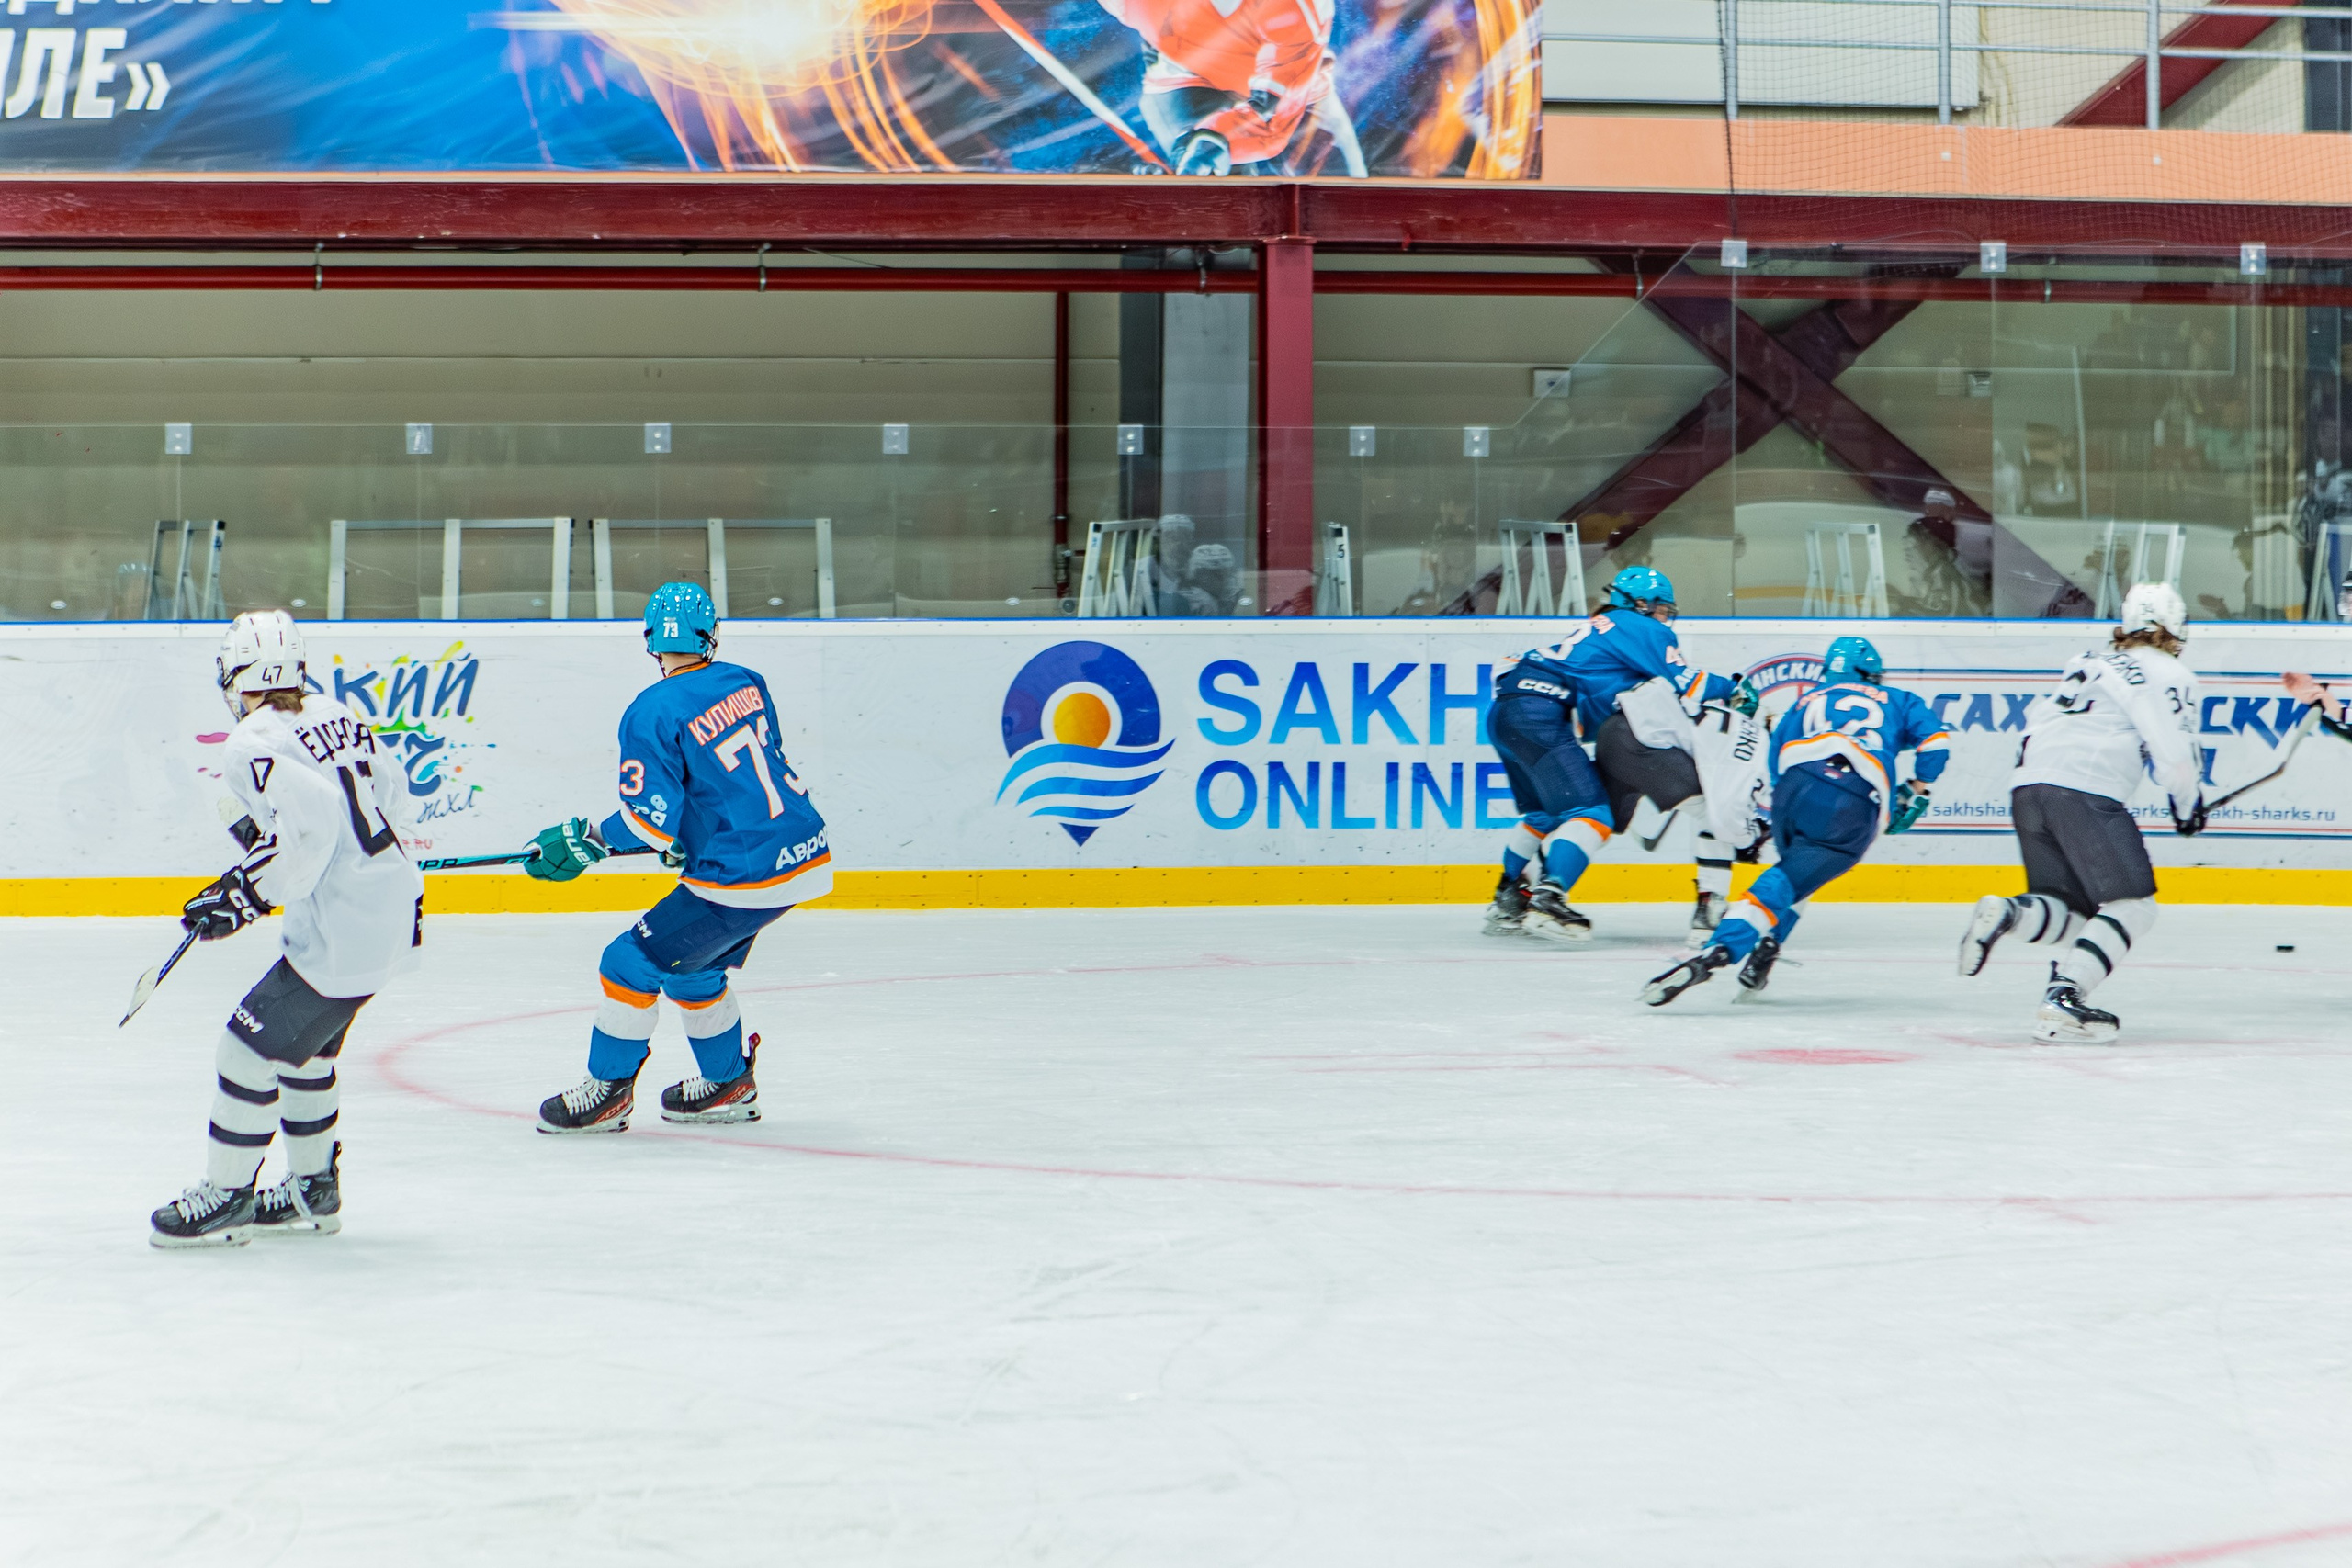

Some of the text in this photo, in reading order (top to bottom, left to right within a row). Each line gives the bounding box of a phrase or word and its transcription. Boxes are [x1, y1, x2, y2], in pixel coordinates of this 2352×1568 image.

[663, 622, 678, 638] 73
[261, 665, 283, 684] 47
[305, 652, 479, 718] КИЙ
[1517, 679, 1570, 700] CCM
[1197, 659, 1494, 746] SAKH
[1196, 760, 1521, 830] ONLINE
